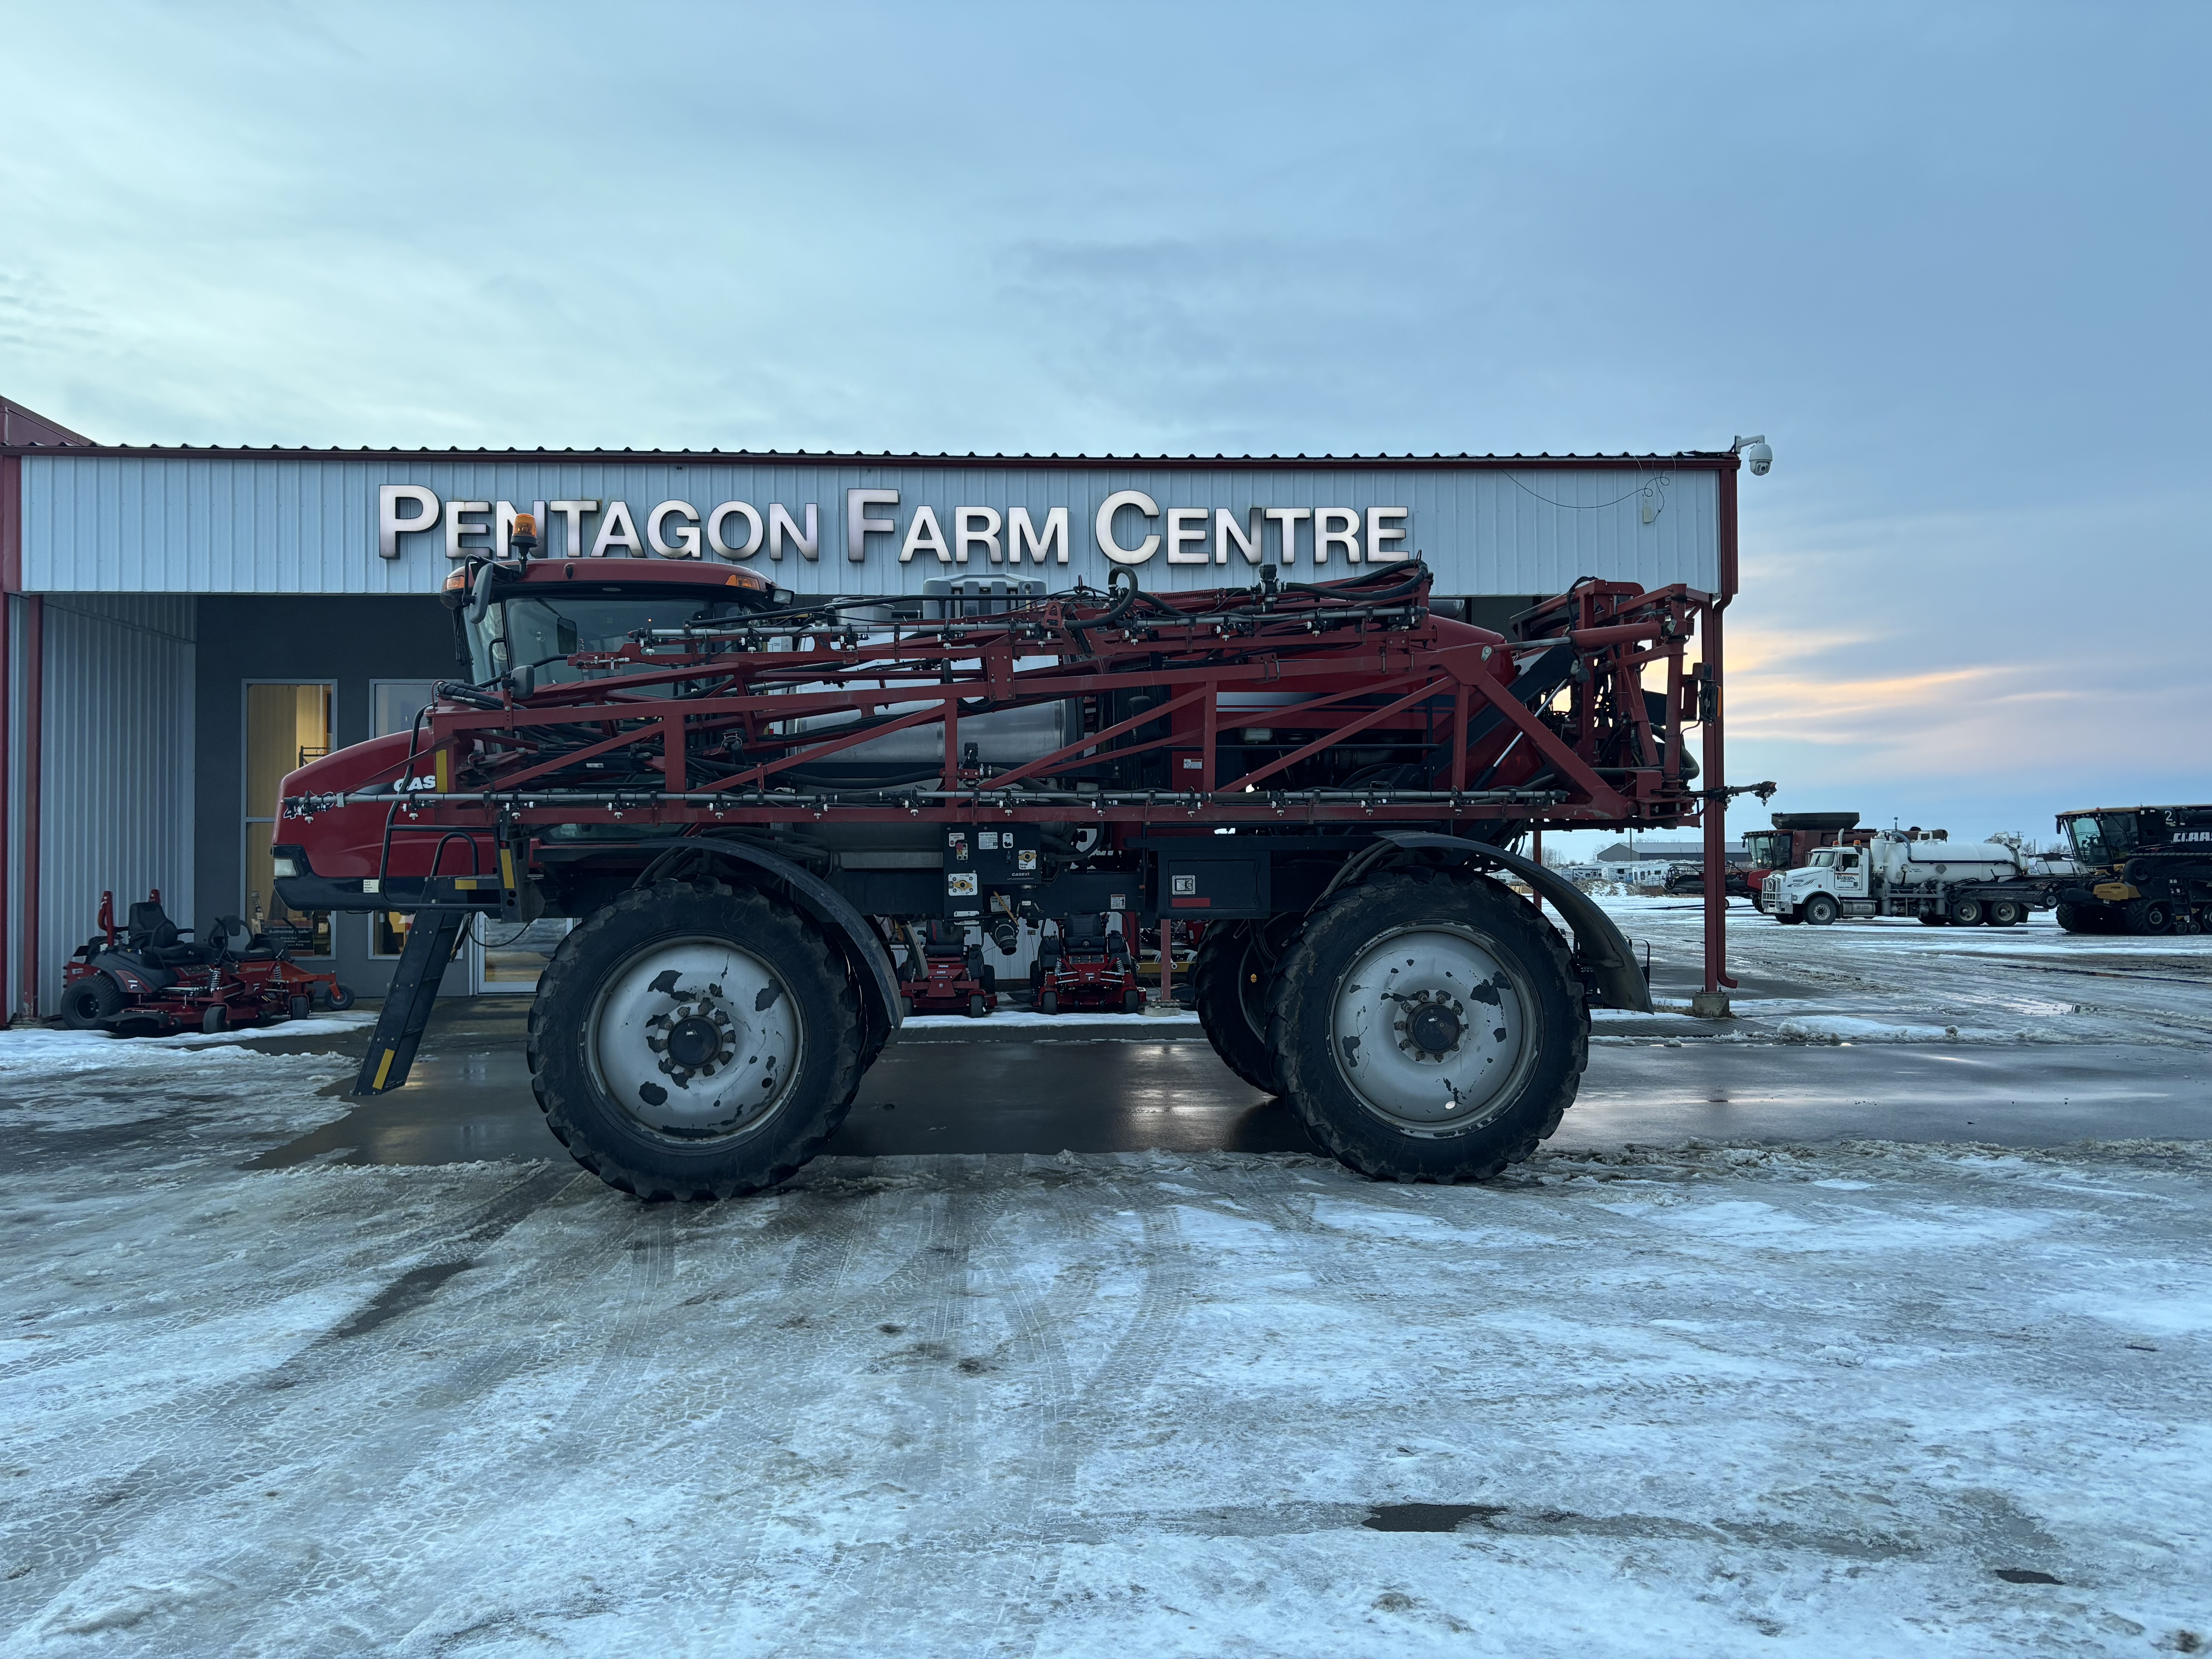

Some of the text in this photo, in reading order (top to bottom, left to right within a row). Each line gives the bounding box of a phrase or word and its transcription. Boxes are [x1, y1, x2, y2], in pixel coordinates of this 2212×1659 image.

[379, 484, 1410, 565] PENTAGON FARM CENTRE
[394, 775, 436, 792] CAS
[2165, 811, 2173, 821] 2
